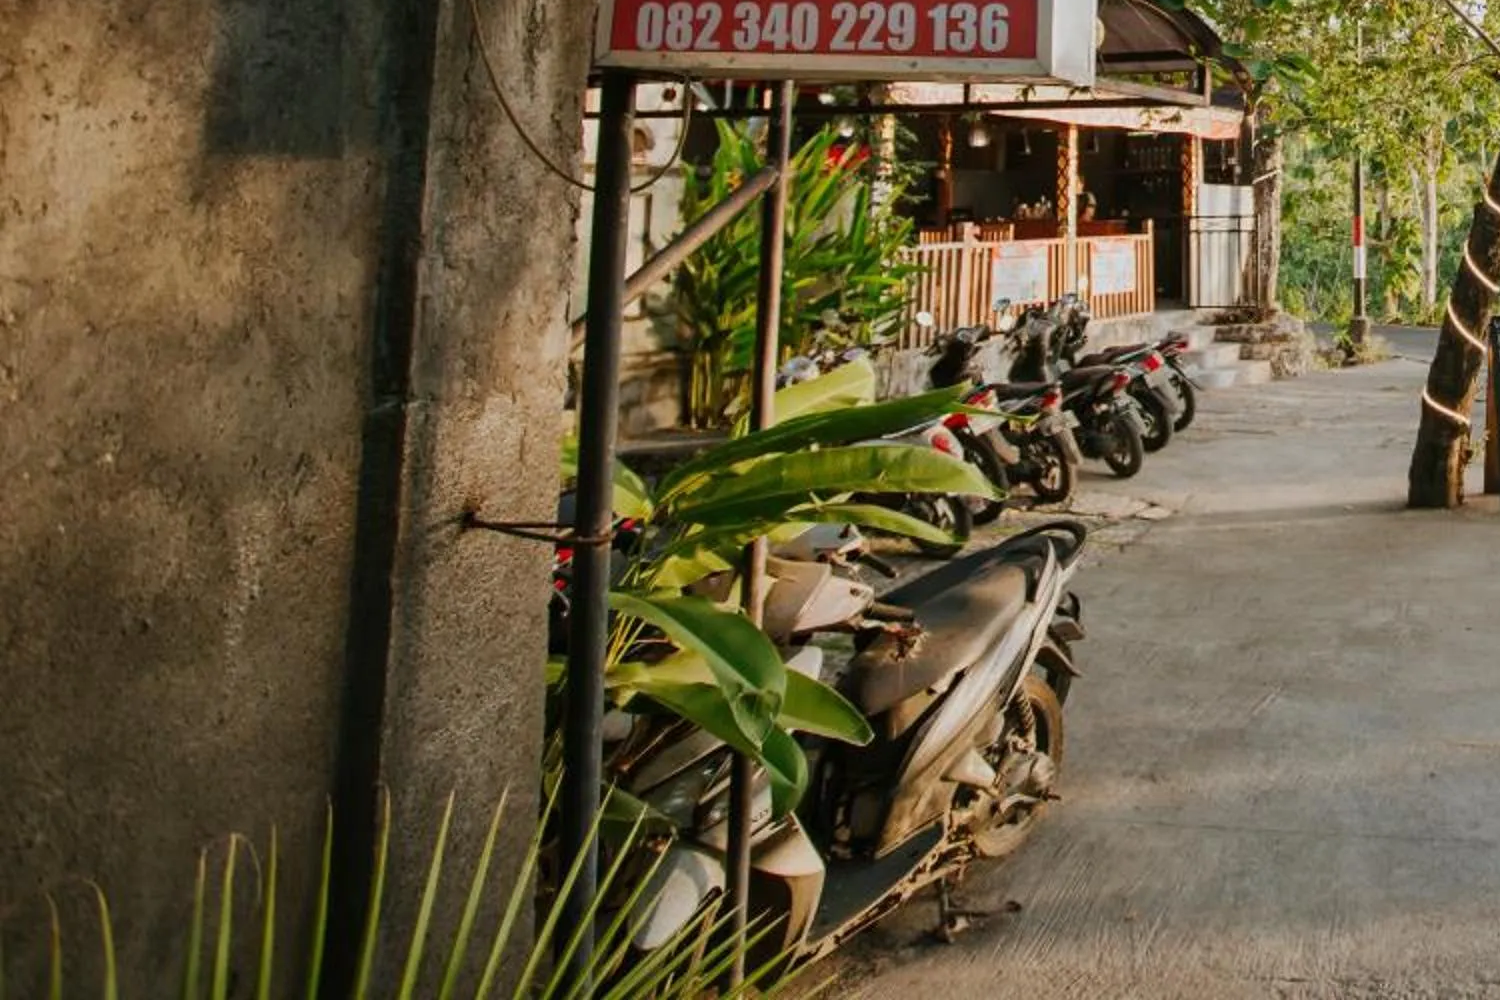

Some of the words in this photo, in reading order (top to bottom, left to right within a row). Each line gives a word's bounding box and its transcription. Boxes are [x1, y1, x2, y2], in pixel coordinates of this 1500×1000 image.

[636, 2, 721, 50] 082
[732, 3, 819, 51] 340
[830, 2, 915, 51] 229
[928, 3, 1009, 52] 136
